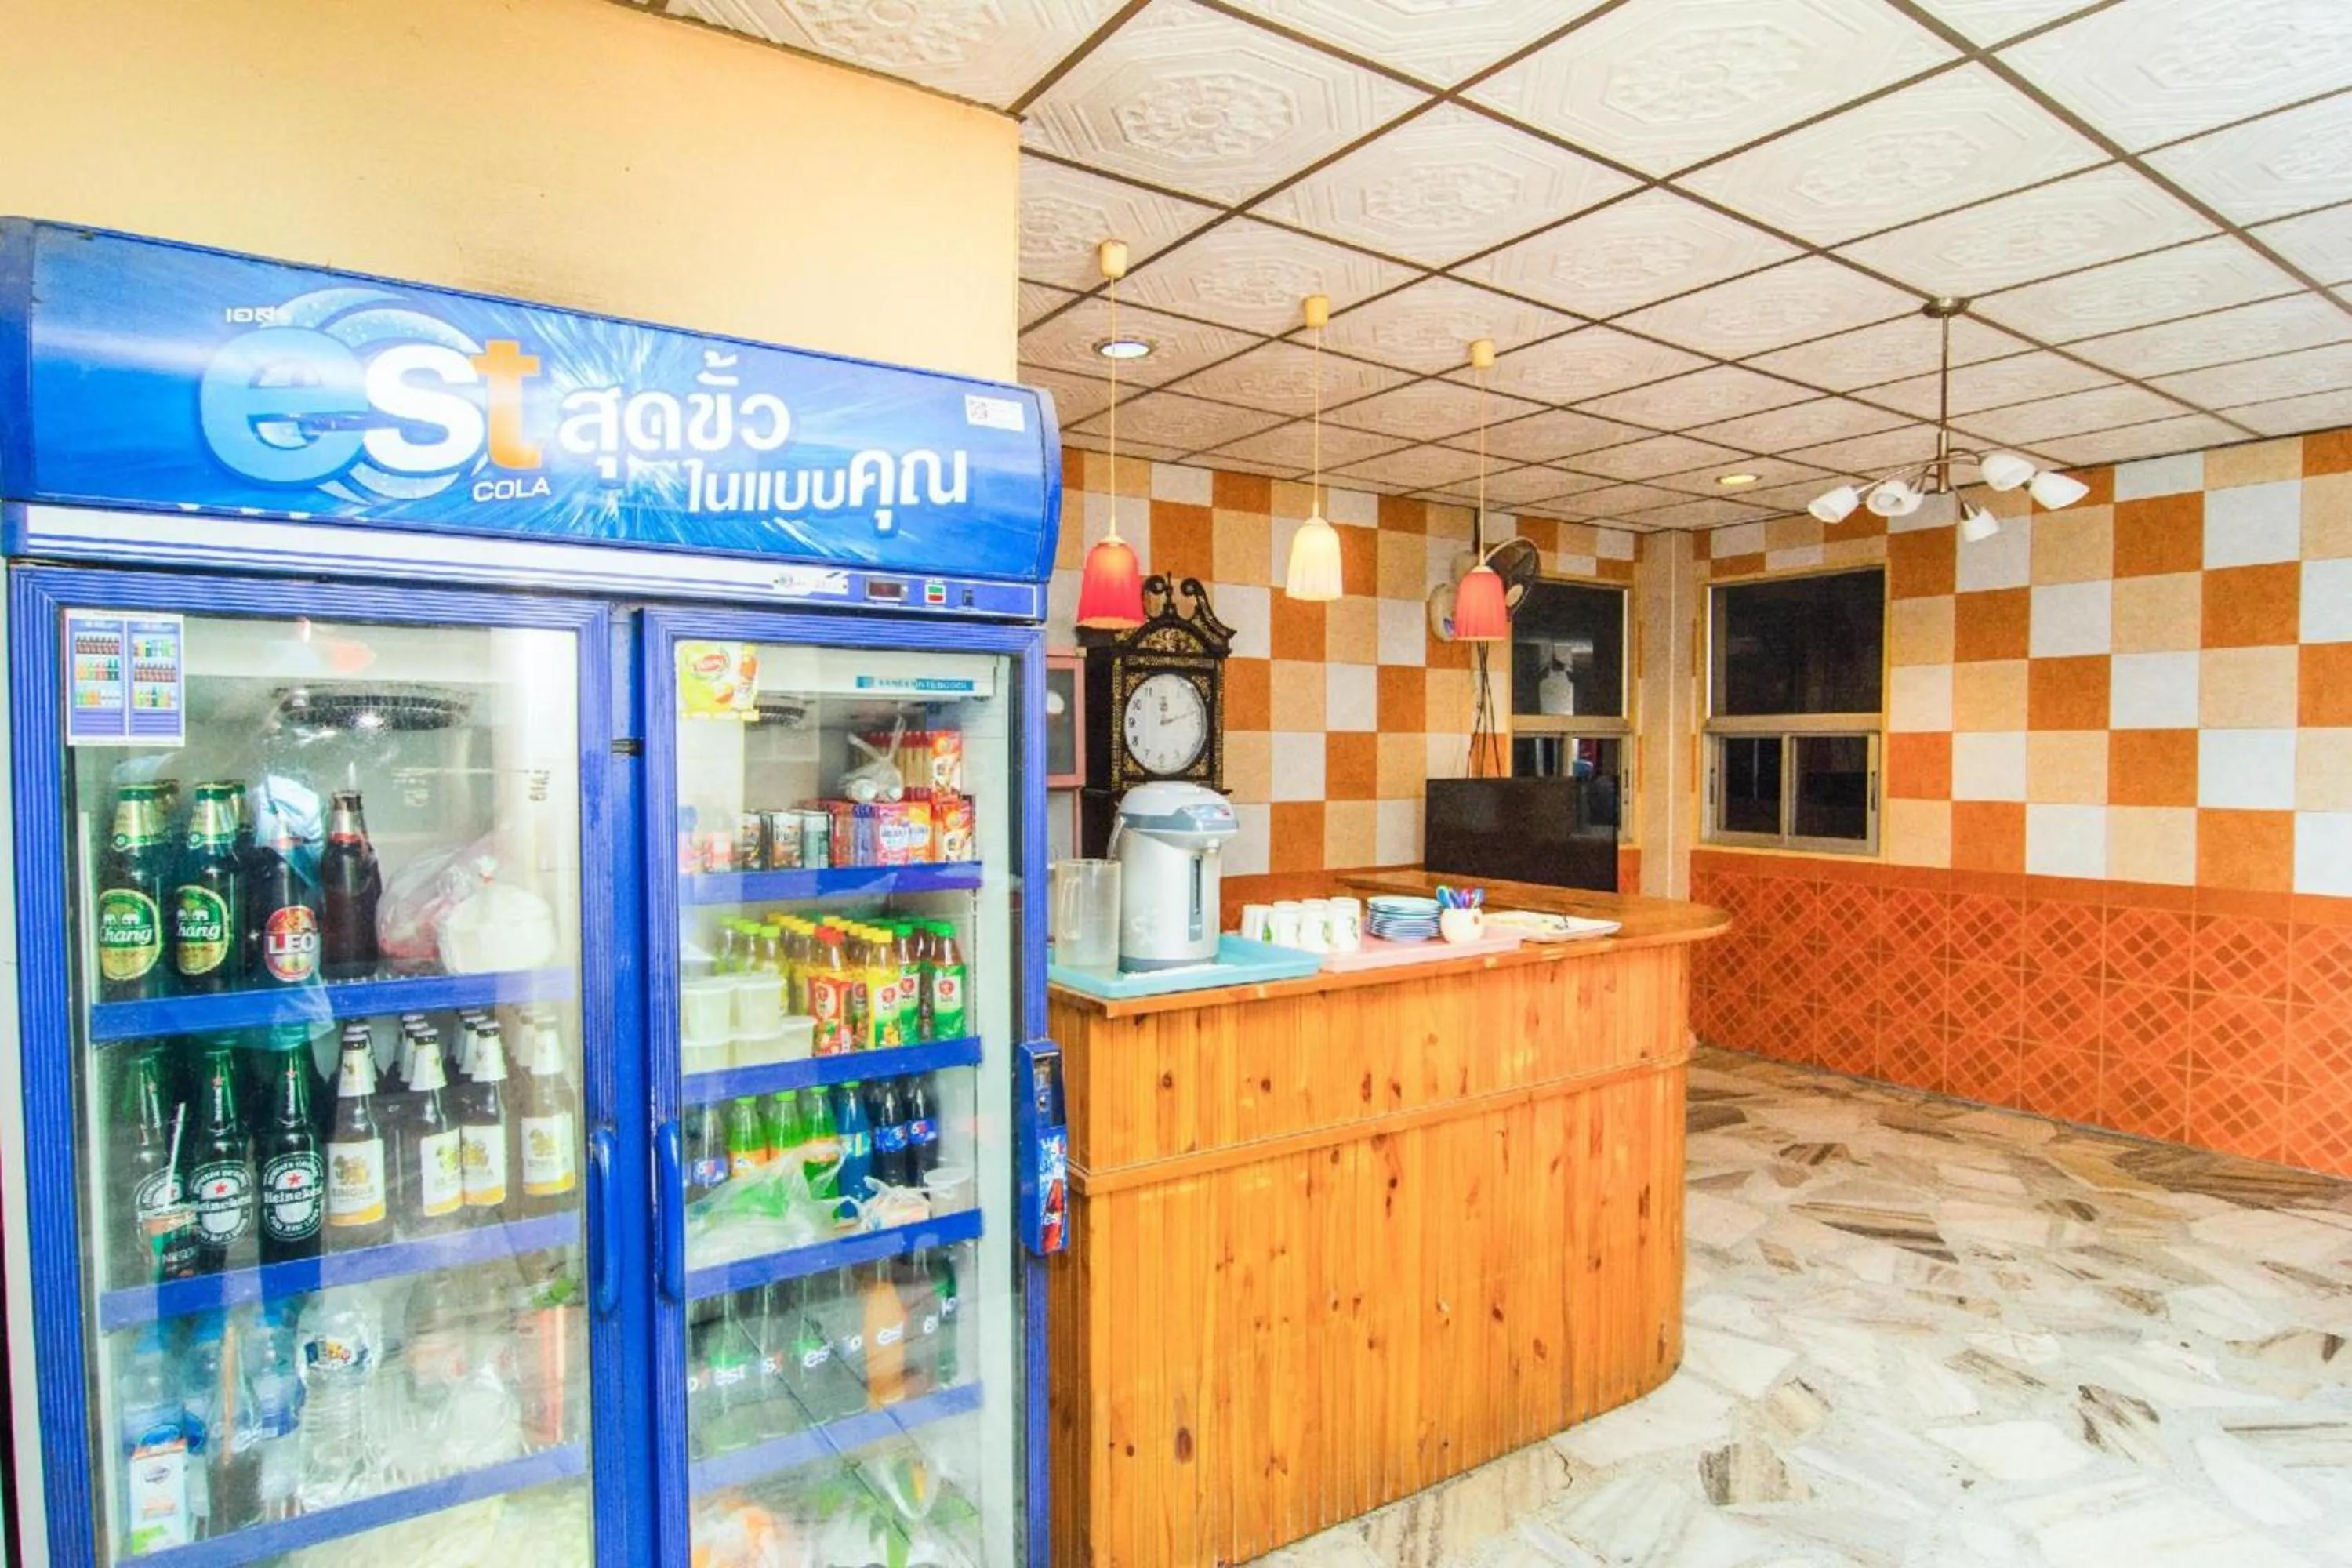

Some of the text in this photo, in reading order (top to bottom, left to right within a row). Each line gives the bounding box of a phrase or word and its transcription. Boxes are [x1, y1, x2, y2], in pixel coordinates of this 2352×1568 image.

[201, 339, 542, 483] est
[557, 350, 792, 480] สุดขั้ว
[472, 477, 551, 503] COLA
[682, 448, 968, 532] ในแบบคุณ
[268, 932, 314, 954] LEO
